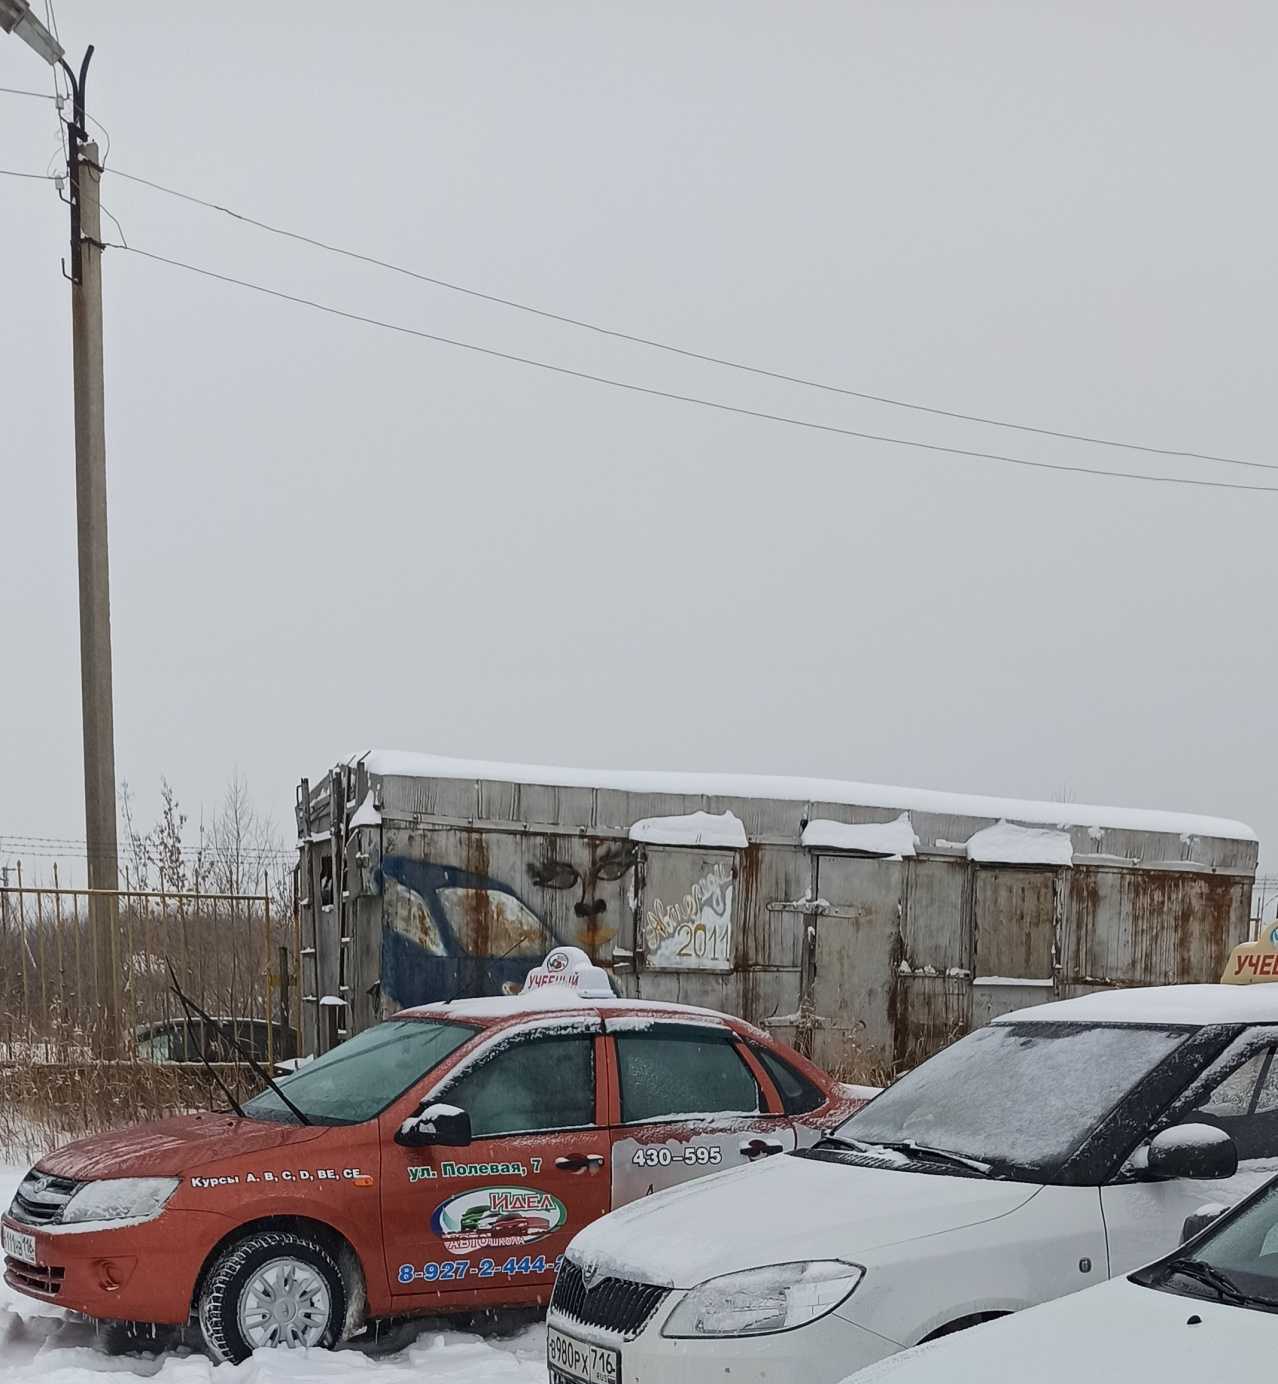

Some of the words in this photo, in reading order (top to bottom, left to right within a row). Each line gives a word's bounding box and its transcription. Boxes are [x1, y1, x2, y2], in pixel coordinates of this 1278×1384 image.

[676, 922, 731, 962] 2011
[407, 1165, 438, 1181] ул.
[441, 1160, 527, 1178] Полевая,
[531, 1157, 544, 1173] 7
[190, 1177, 240, 1188] Курсы
[591, 1348, 614, 1375] 716
